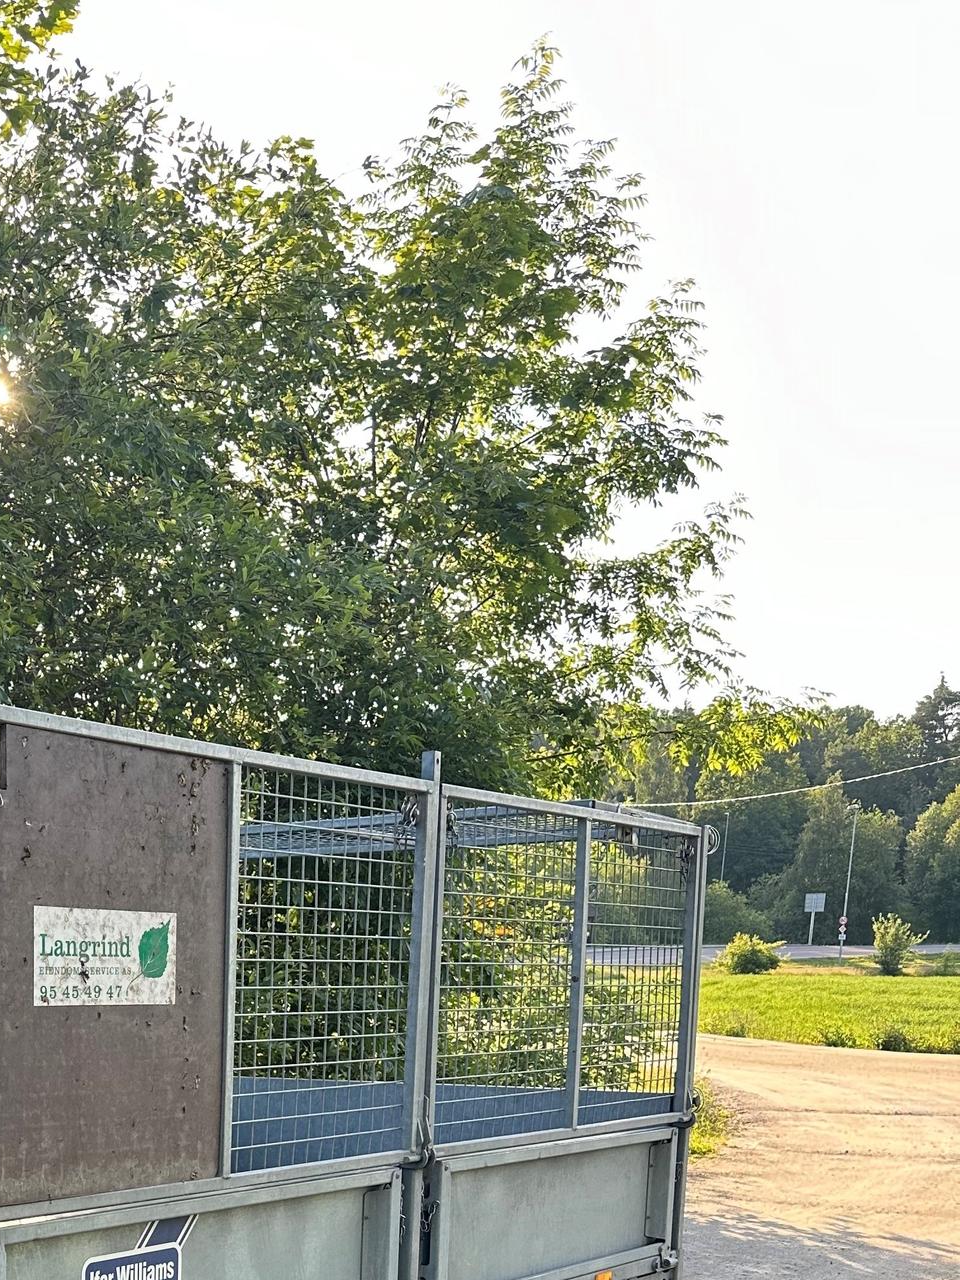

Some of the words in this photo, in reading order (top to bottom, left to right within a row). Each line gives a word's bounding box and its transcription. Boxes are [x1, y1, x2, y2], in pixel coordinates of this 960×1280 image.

[40, 933, 131, 964] Langrind
[40, 985, 57, 999] 95
[62, 985, 79, 999] 45
[84, 985, 102, 999] 49
[106, 985, 122, 1000] 47
